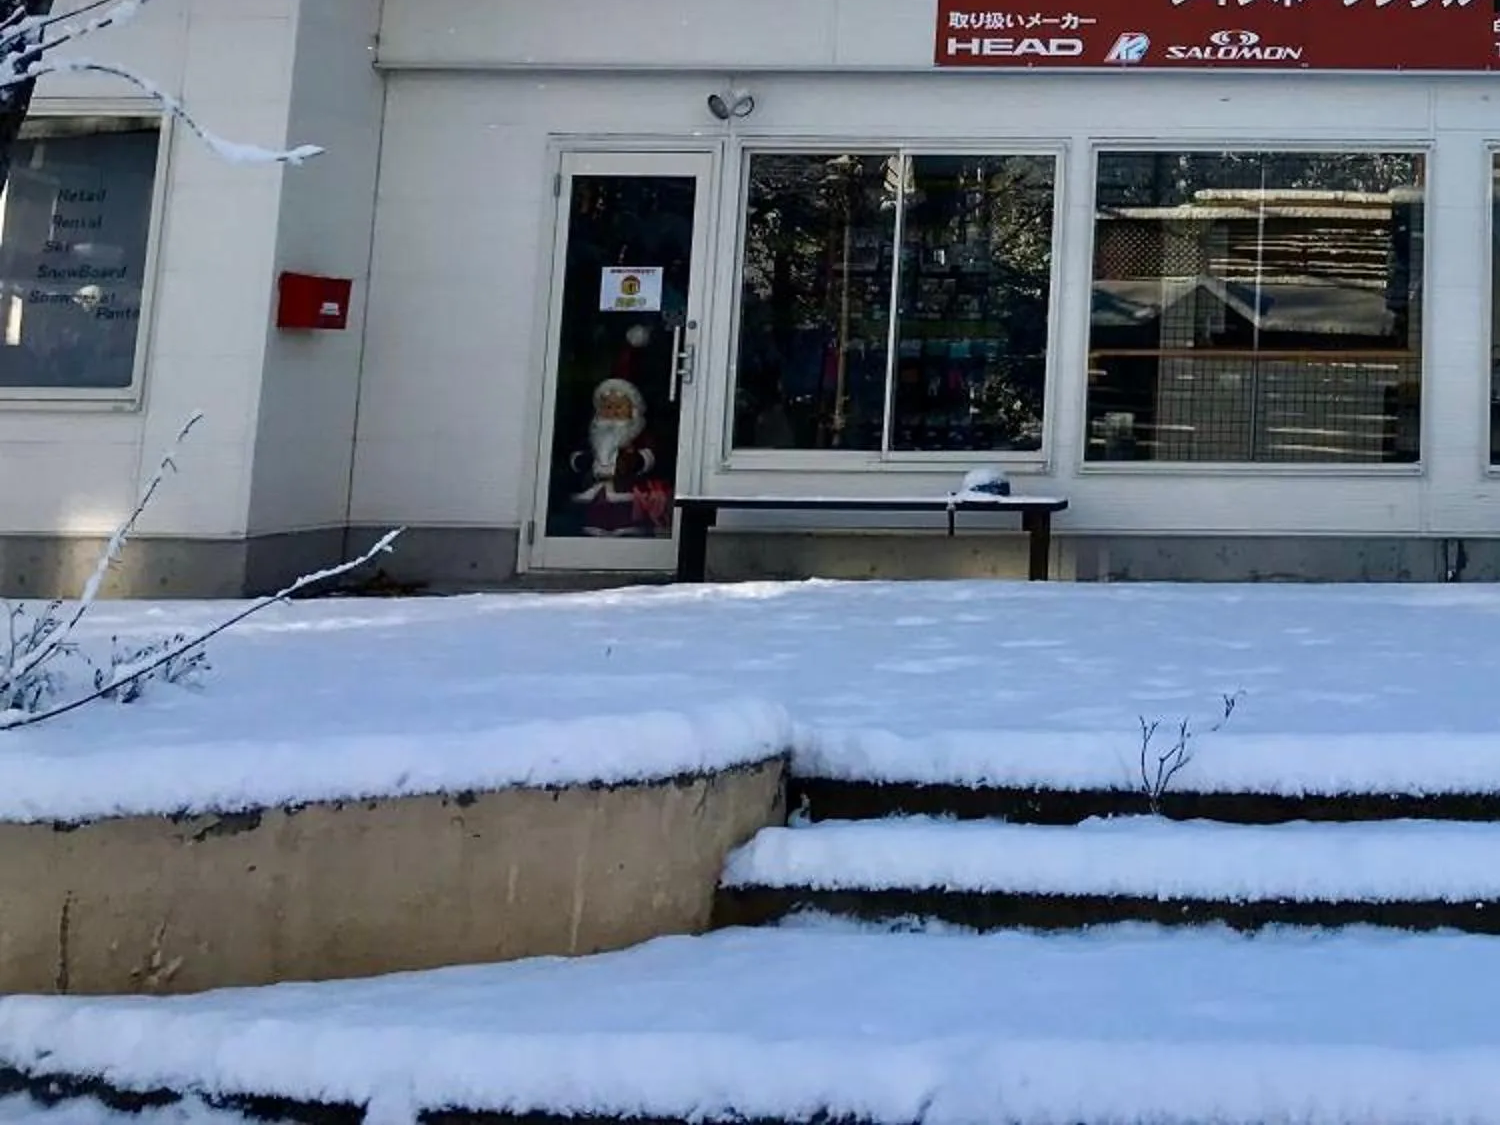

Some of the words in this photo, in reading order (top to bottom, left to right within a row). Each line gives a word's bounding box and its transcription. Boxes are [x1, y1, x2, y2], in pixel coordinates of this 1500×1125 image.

[949, 11, 1097, 30] 取り扱いメーカー
[947, 38, 1083, 56] HEAD
[1165, 46, 1303, 60] SALOMON
